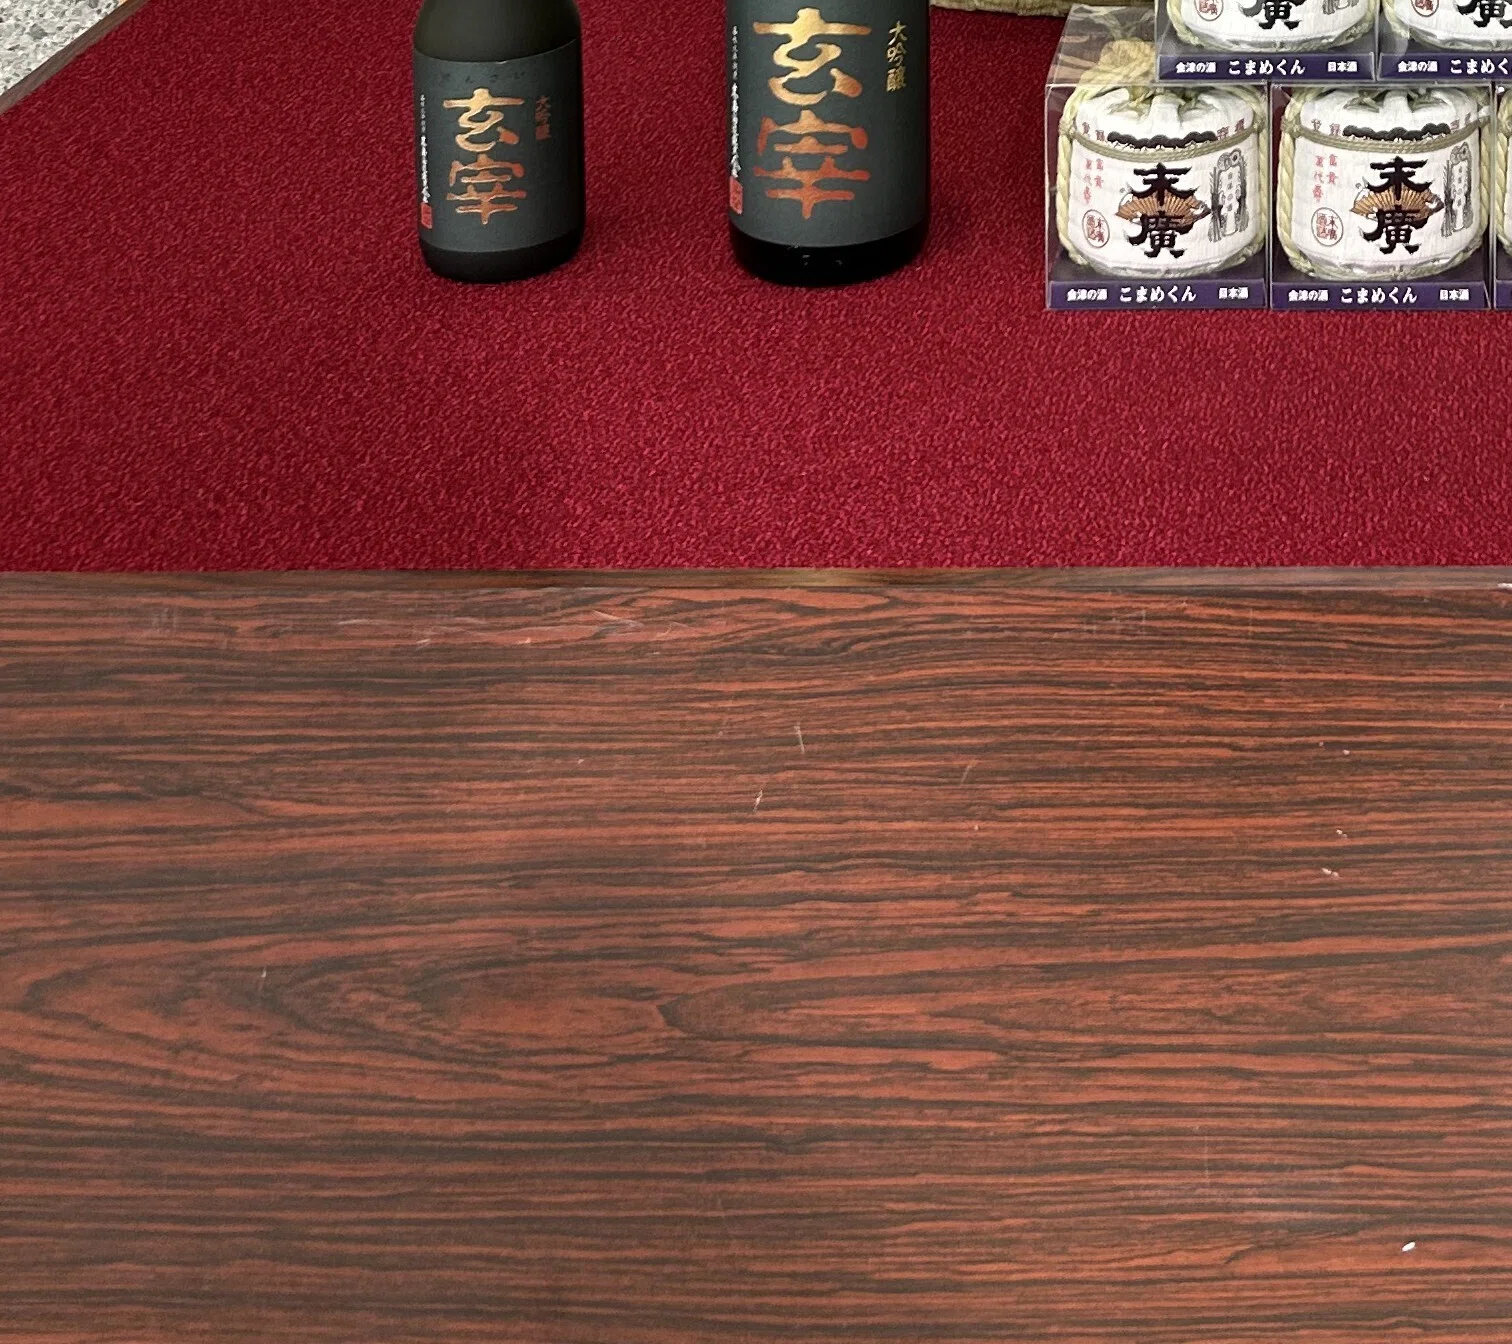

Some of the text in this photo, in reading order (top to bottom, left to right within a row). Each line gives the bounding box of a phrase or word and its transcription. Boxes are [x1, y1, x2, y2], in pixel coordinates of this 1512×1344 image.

[1228, 58, 1306, 76] こまめくん
[1119, 285, 1197, 304] こまめくん
[1341, 286, 1418, 305] こまめくん
